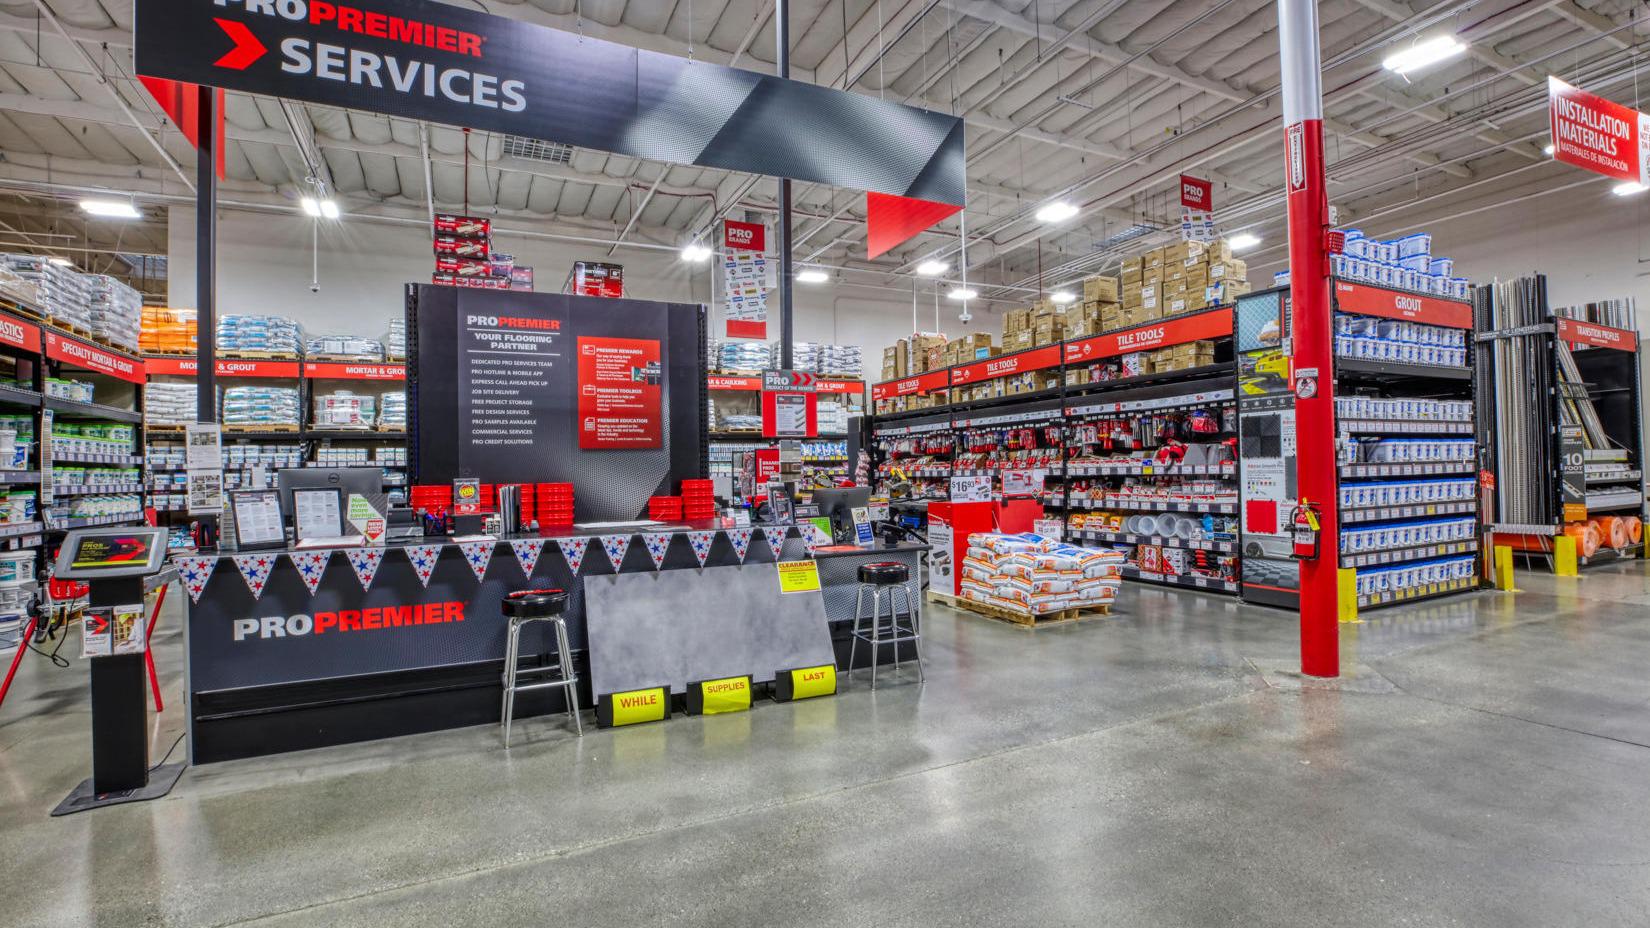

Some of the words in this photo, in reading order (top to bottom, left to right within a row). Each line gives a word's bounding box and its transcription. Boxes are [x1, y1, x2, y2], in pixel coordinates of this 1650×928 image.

[214, 0, 483, 57] ROPREMIER
[281, 37, 527, 112] SERVICES
[1558, 96, 1630, 140] INSTALLATION
[1560, 118, 1616, 156] MATERIALS
[1561, 140, 1590, 160] MATERIALES
[1590, 152, 1598, 162] DE
[1184, 184, 1203, 197] PRO
[728, 228, 753, 239] PRO
[1395, 296, 1422, 312] GROUT
[467, 315, 560, 330] PROPREMIER
[504, 334, 552, 343] FLOORING
[1117, 334, 1134, 346] TILE
[1136, 328, 1164, 341] TOOLS
[491, 342, 537, 350] PARTNER
[62, 342, 91, 360] SPECIALTY
[118, 360, 133, 374] GROUT
[987, 362, 998, 372] TILE
[999, 358, 1018, 369] TOOLS
[766, 377, 789, 385] PRO
[1563, 453, 1583, 466] 10
[234, 601, 464, 641] PROPREMIER
[803, 672, 825, 681] LAST
[707, 682, 745, 694] SUPPLIES
[620, 694, 657, 708] WHILE
